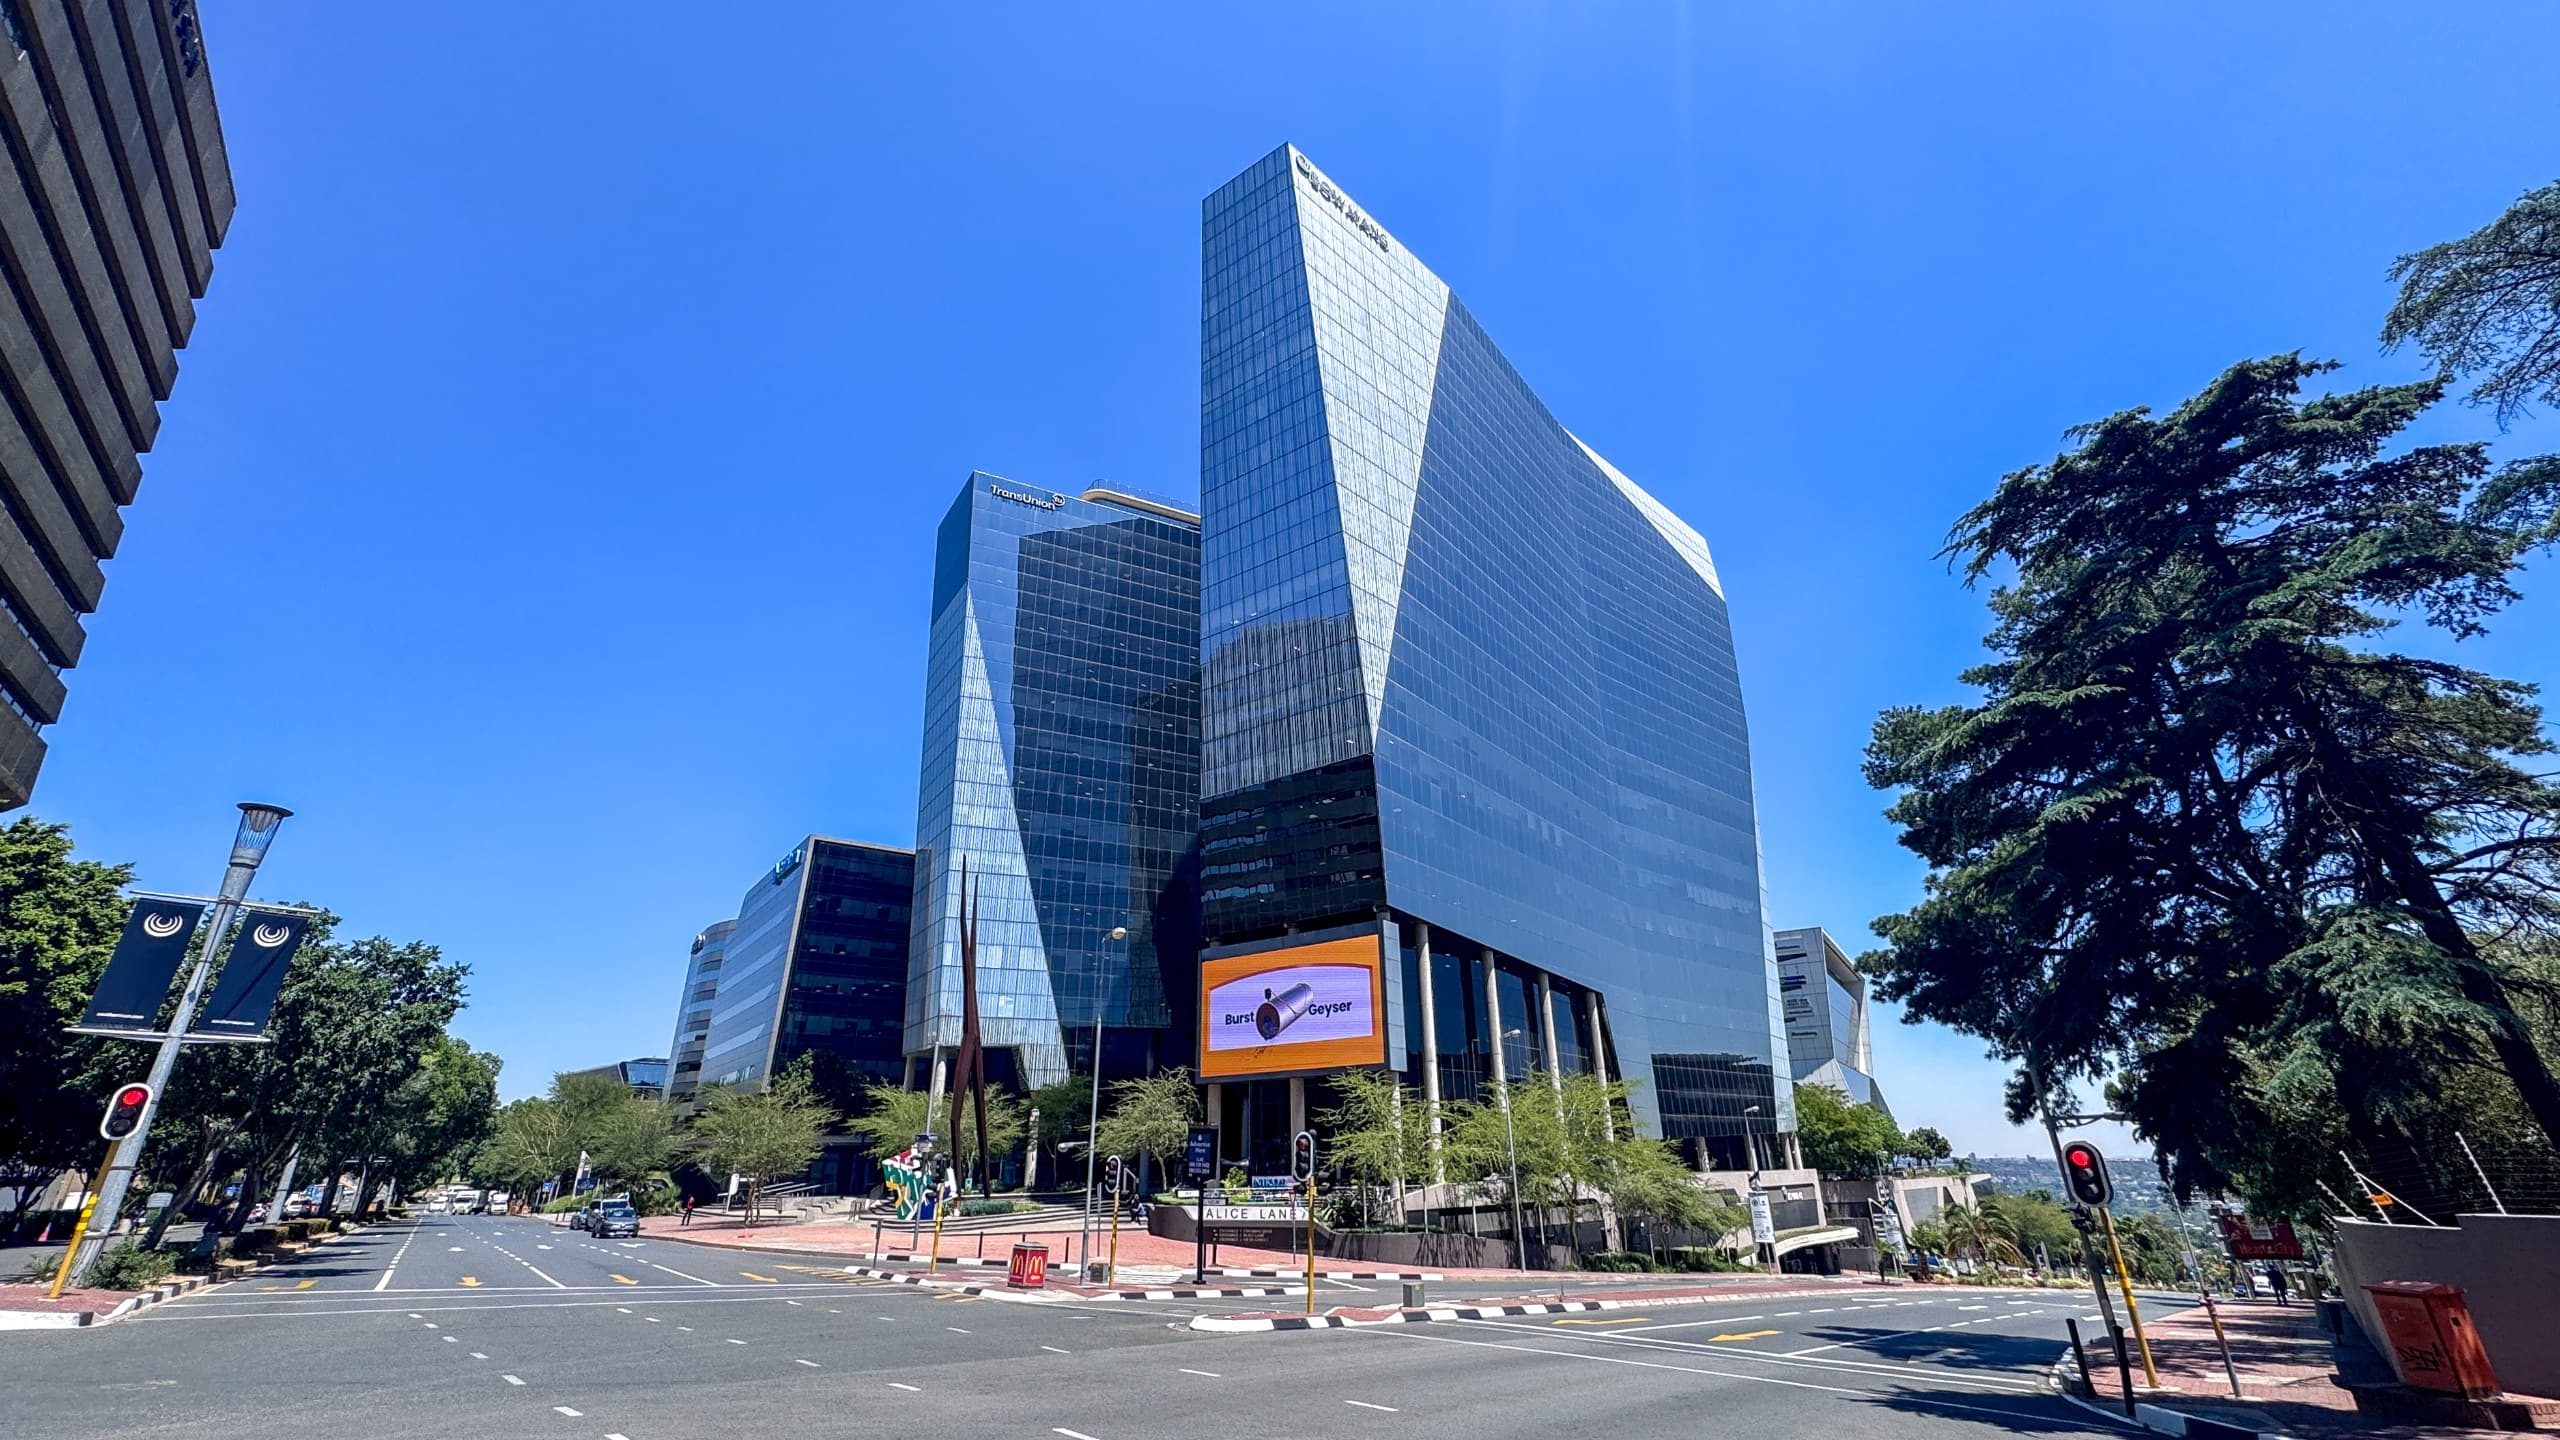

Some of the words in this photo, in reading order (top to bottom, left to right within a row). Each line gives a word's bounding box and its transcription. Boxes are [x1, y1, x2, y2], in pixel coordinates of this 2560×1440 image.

[991, 484, 1056, 511] TransUnion
[1308, 1001, 1352, 1018] Geyser
[1225, 1012, 1254, 1025] Burst
[1206, 1208, 1248, 1219] ALICE
[1260, 1208, 1297, 1219] LANE
